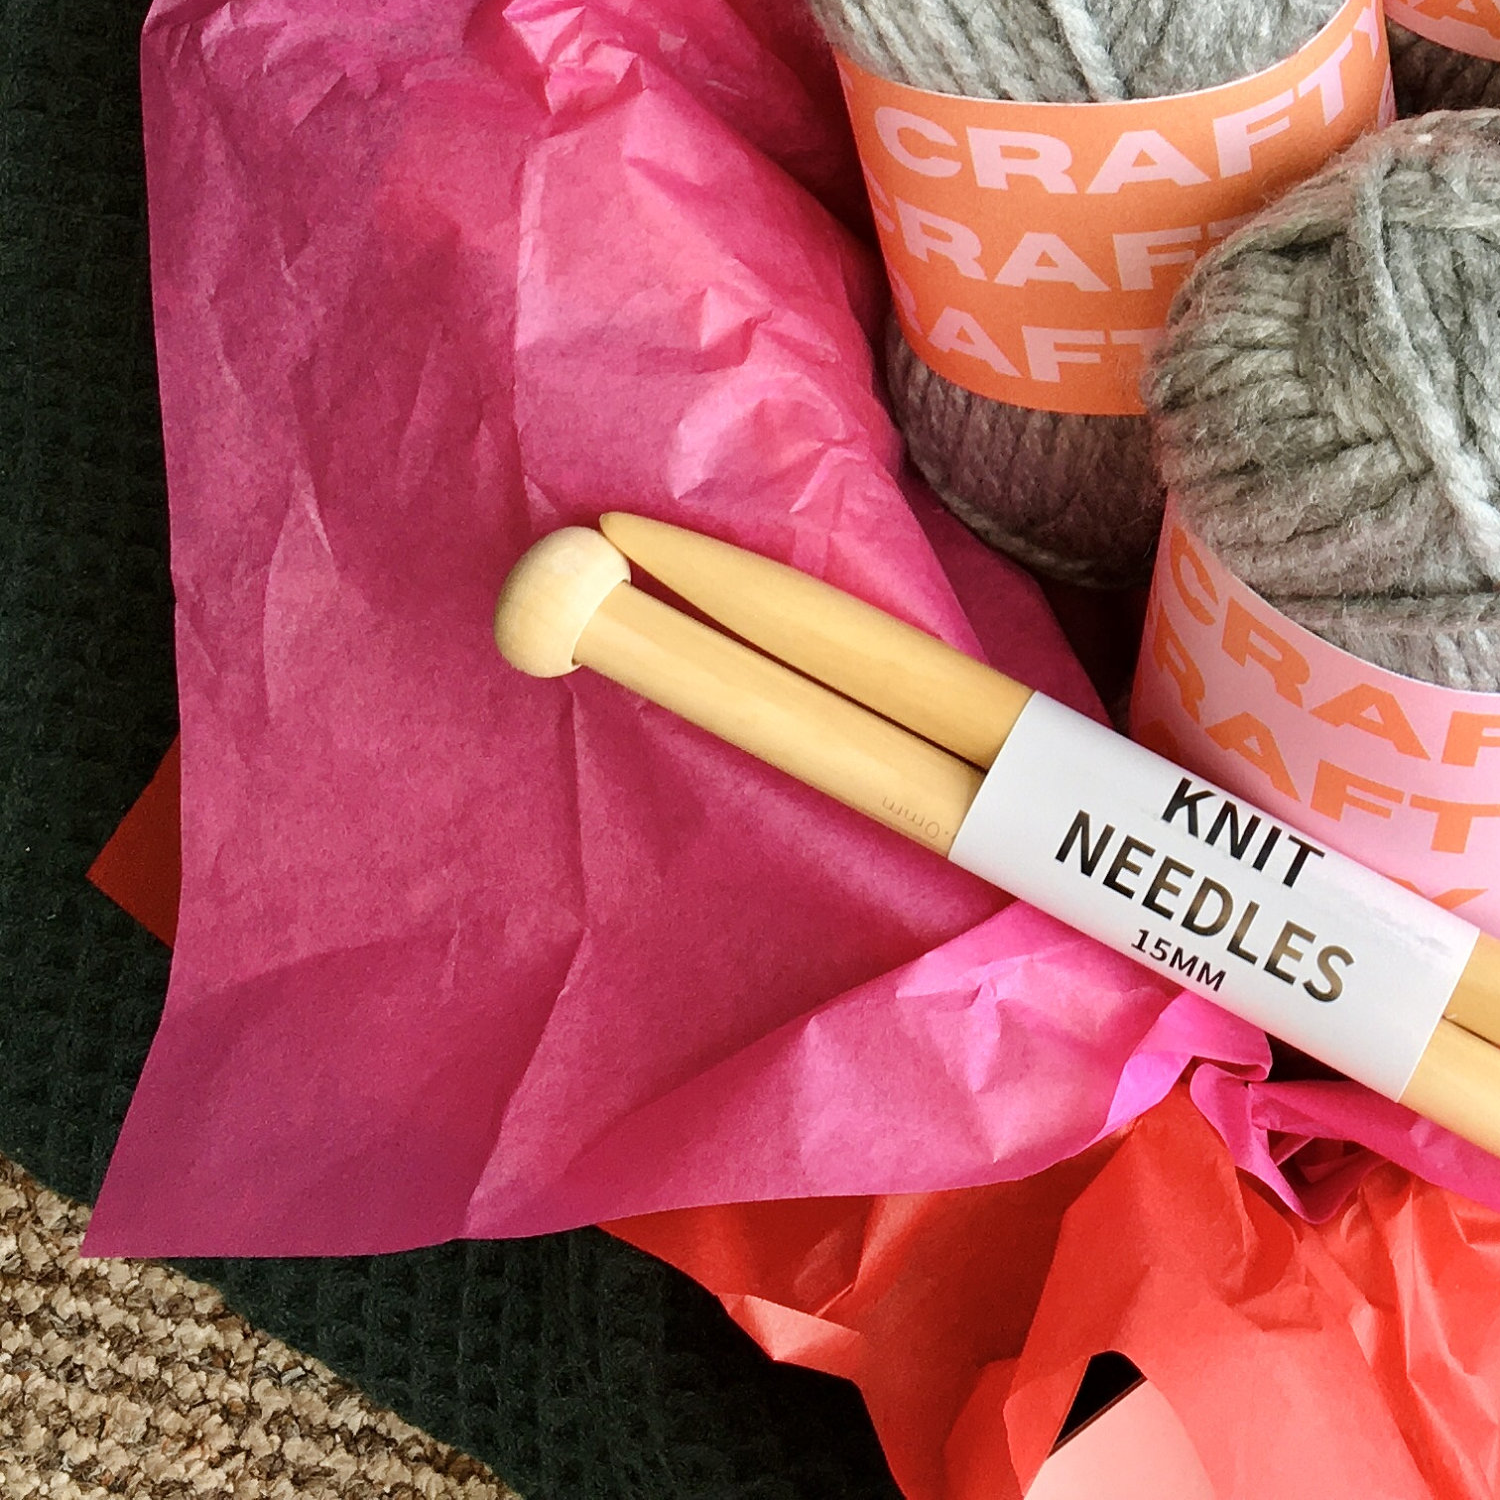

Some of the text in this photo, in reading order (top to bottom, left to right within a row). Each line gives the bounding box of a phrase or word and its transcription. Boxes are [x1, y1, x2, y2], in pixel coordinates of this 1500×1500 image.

[1161, 778, 1325, 890] KNIT
[1055, 810, 1354, 1003] NEEDLES
[1131, 928, 1227, 992] 15MM
